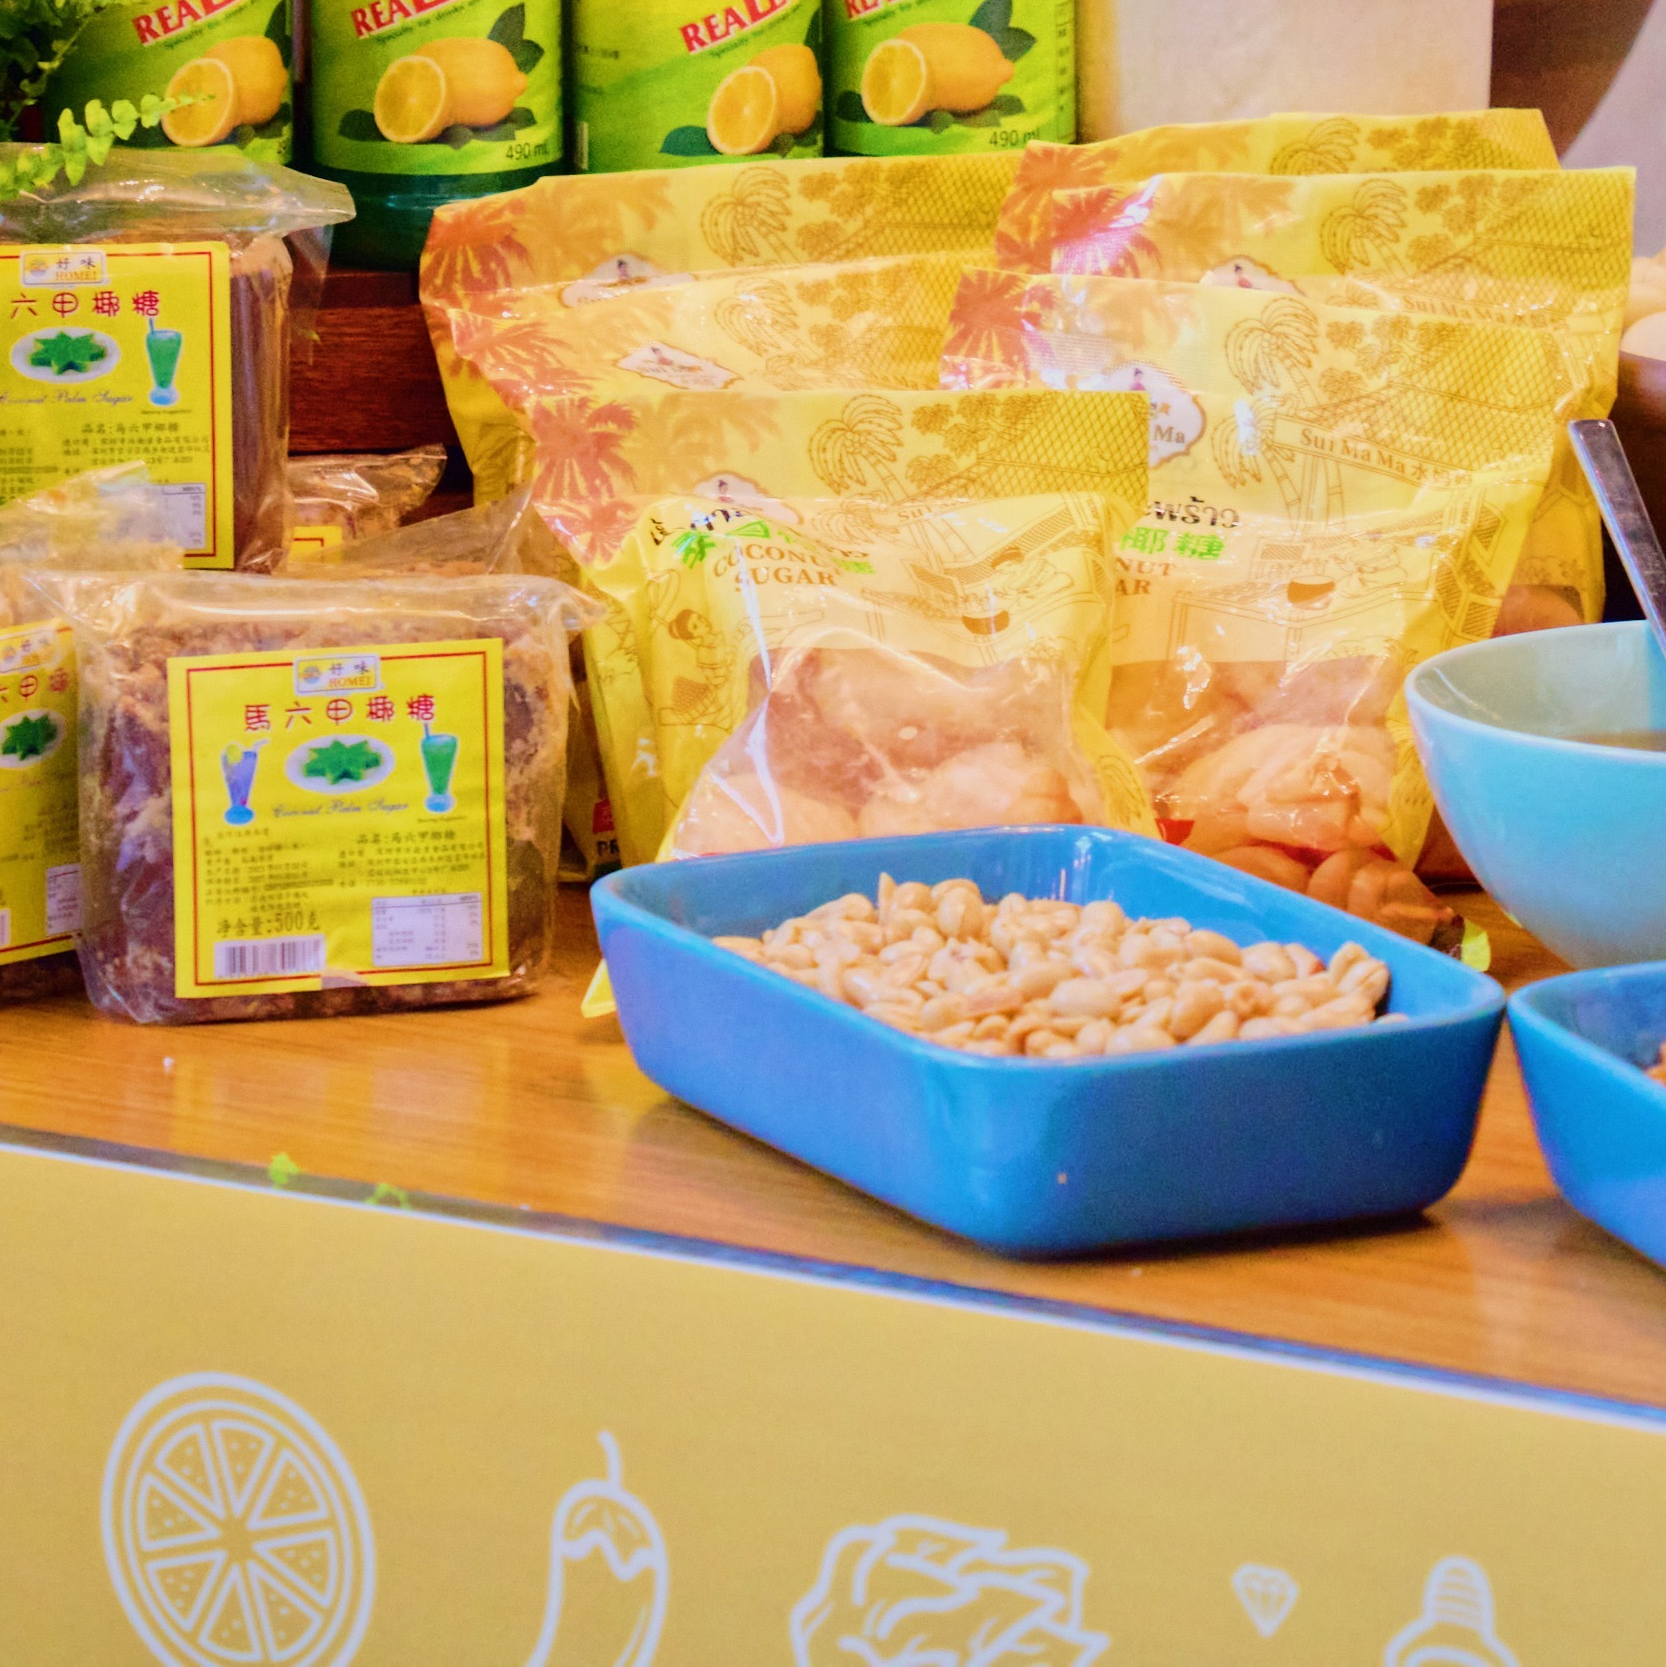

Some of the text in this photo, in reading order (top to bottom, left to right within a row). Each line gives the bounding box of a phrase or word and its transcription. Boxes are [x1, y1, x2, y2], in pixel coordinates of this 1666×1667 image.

[989, 130, 1018, 147] 490
[505, 142, 531, 160] 490
[245, 693, 436, 732] 馬六甲椰糖
